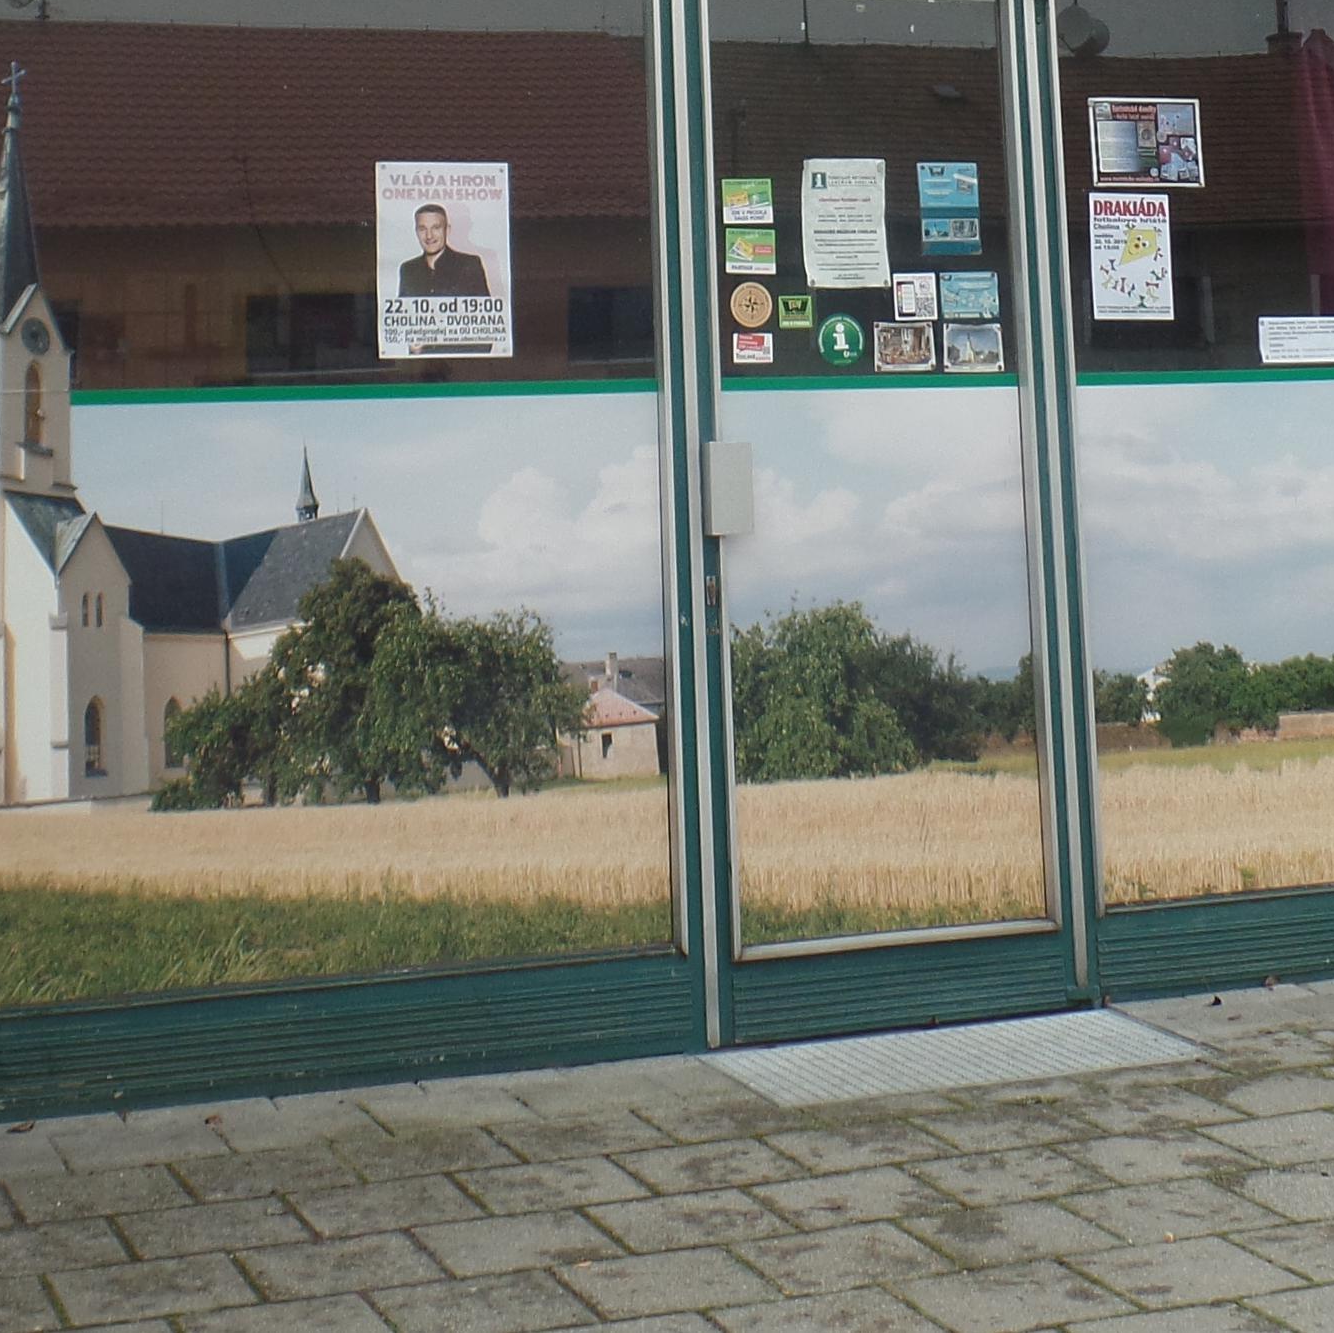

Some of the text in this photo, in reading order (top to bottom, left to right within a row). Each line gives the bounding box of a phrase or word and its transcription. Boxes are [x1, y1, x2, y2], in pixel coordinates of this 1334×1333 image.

[450, 175, 496, 187] HRON
[1093, 197, 1167, 217] DRAKIÁDA
[385, 298, 503, 314] 22. 10. od 19:00
[384, 315, 436, 327] CHOLINA
[447, 315, 505, 326] DVORANA
